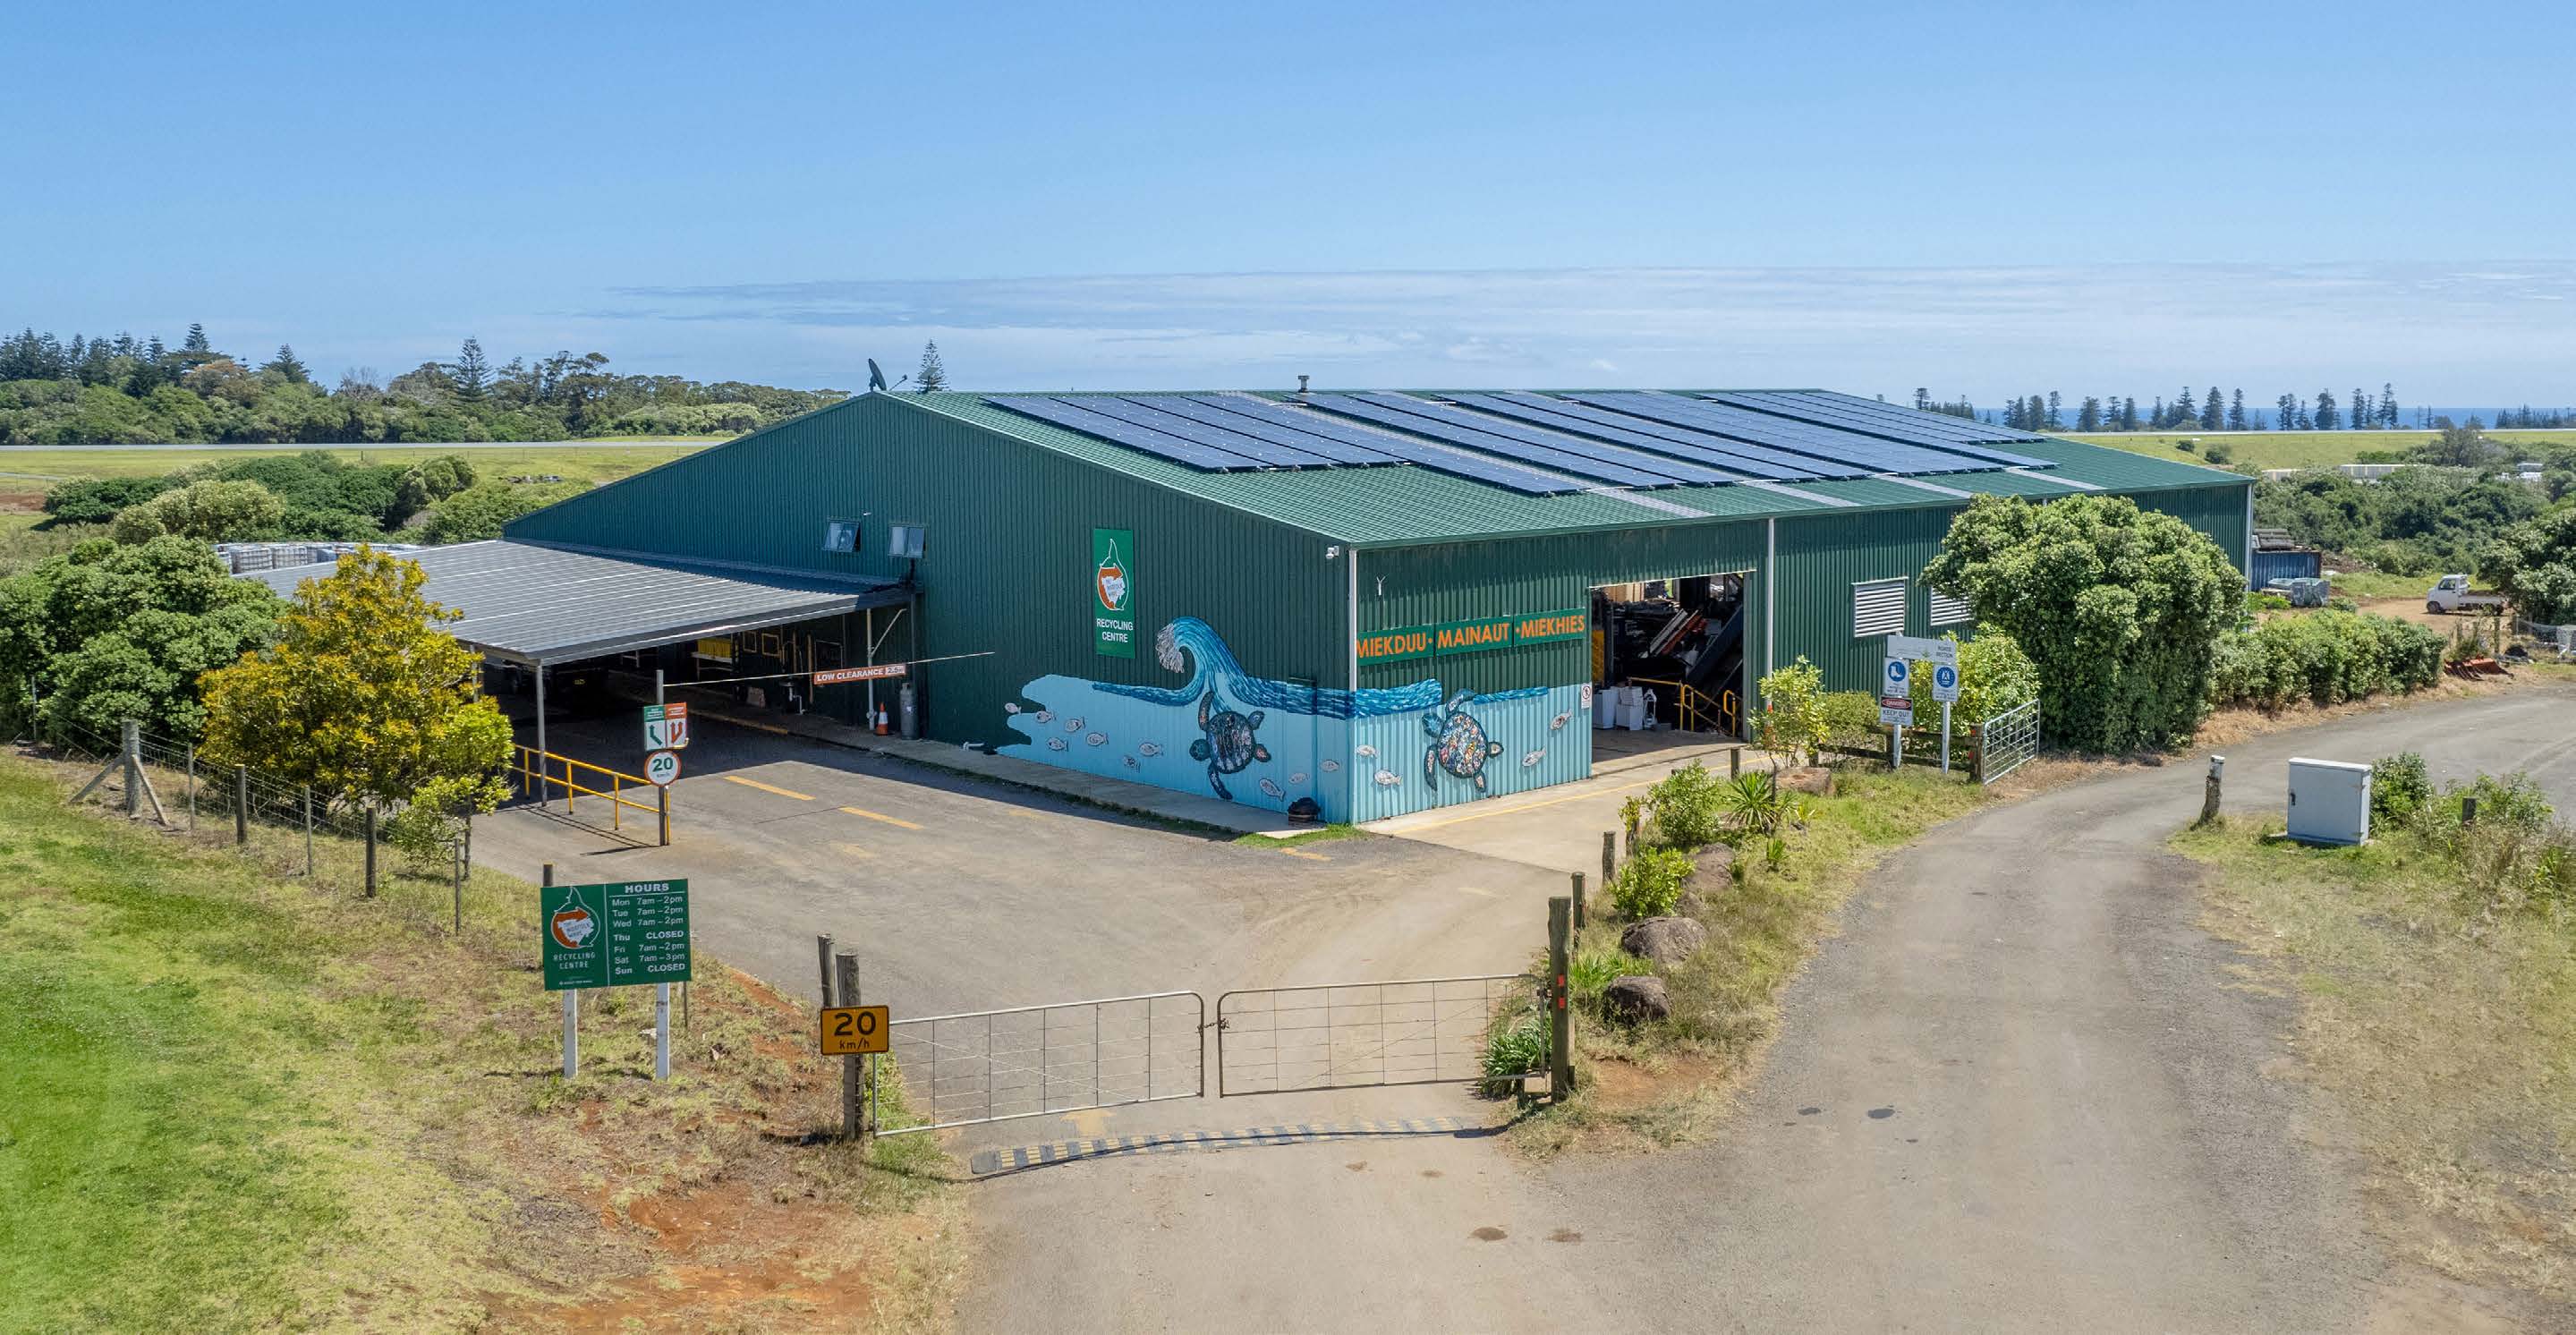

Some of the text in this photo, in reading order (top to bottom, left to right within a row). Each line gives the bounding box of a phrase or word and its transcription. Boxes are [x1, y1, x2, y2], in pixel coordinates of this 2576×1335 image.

[1096, 618, 1134, 631] RECYCLING
[1101, 631, 1128, 642] CENTRE
[1356, 632, 1426, 659] MIEKDUU
[1437, 623, 1510, 649] MAINAUT
[1521, 615, 1586, 639] MIEKHIES
[817, 673, 835, 682] LOW
[837, 668, 884, 680] CLEARANCE
[652, 757, 674, 772] 20
[625, 882, 670, 894] HOURS
[612, 898, 630, 906] Mon
[612, 909, 629, 917] Tue
[613, 920, 632, 928] Wed
[613, 931, 684, 941] Thu CLOSED
[614, 946, 625, 954] Fri
[553, 952, 596, 961] RECYCLING
[615, 956, 629, 965] Sat
[559, 961, 588, 970] CENTRE
[615, 963, 685, 974] Sun CLOSED
[834, 1011, 876, 1036] 20
[839, 1038, 870, 1050] km/h
